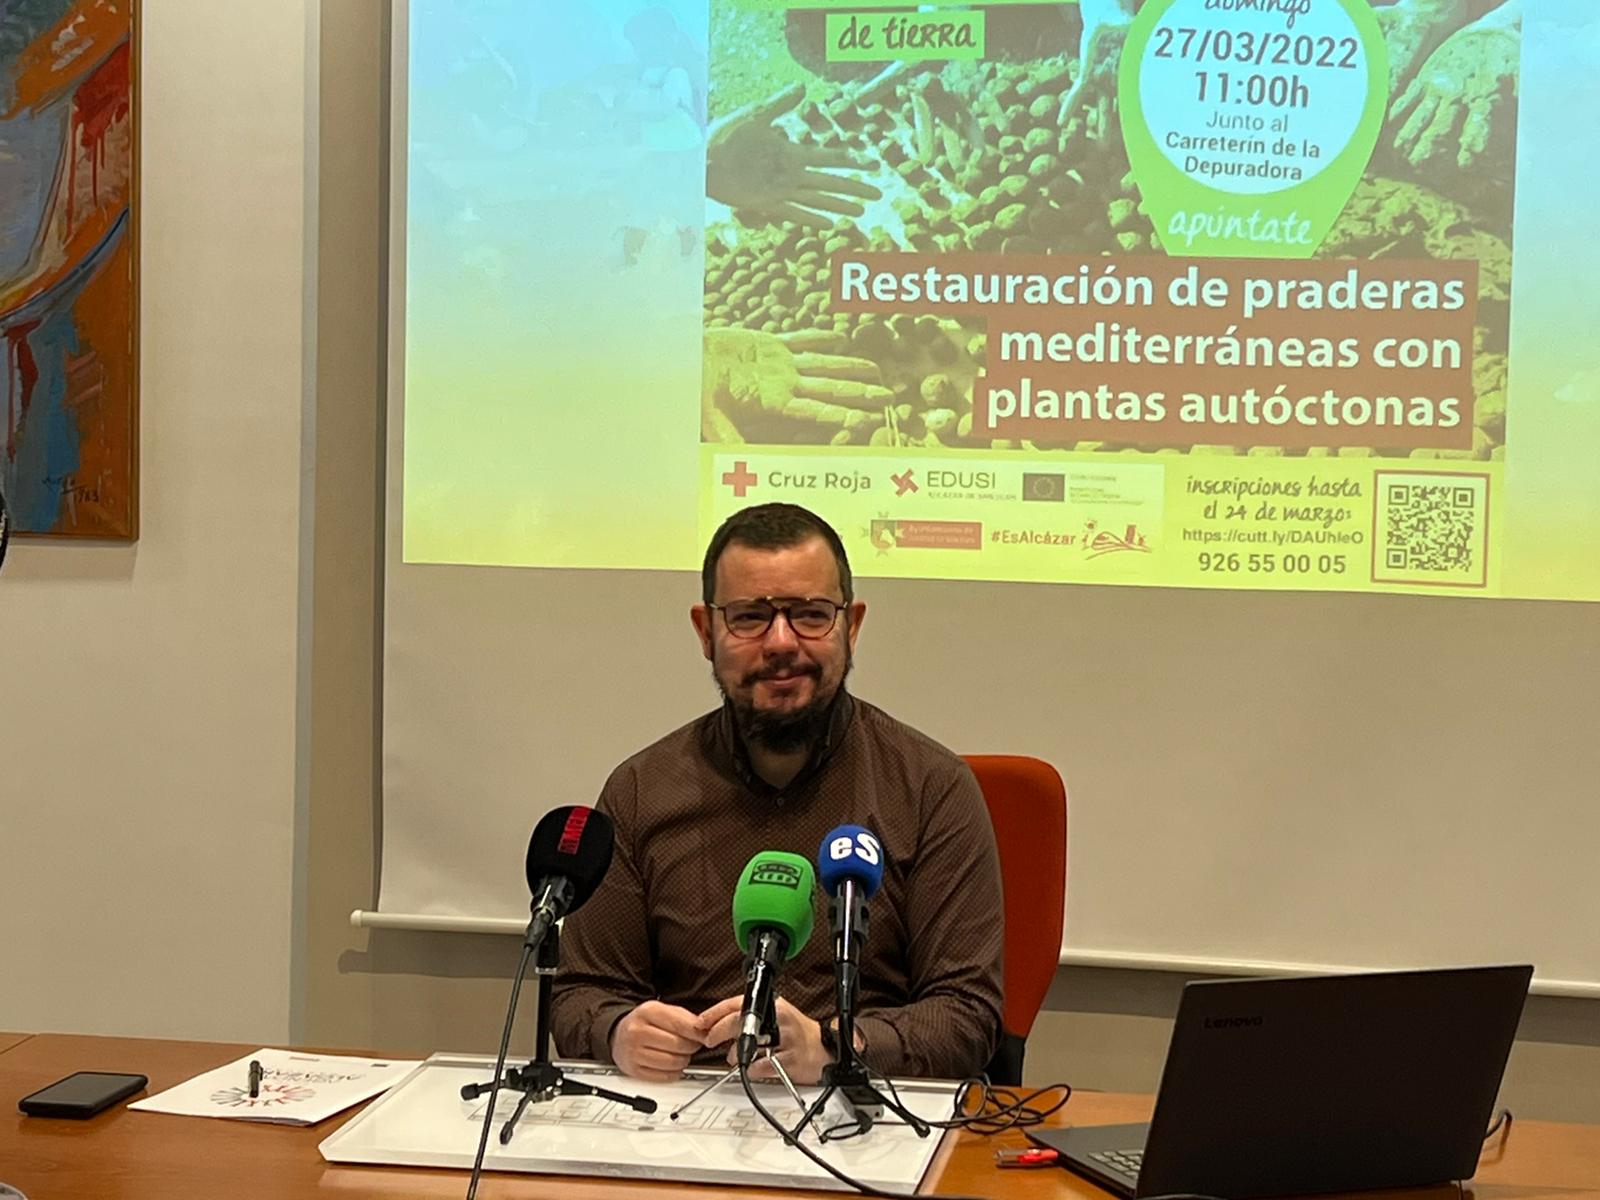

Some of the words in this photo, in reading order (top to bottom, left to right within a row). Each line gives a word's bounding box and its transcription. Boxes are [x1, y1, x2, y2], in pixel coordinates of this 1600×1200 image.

[838, 16, 873, 50] de
[1154, 27, 1359, 69] 27/03/2022
[1195, 71, 1310, 109] 11:00h
[1206, 110, 1265, 132] Junto
[1270, 114, 1289, 133] al
[1165, 131, 1265, 155] Carreterín
[1272, 135, 1295, 157] de
[1302, 138, 1321, 159] la
[1184, 156, 1303, 182] Depuradora
[1168, 205, 1313, 247] apúntate
[841, 262, 1153, 305] Restauración
[1168, 266, 1229, 307] de
[1244, 269, 1465, 318] praderas
[1001, 321, 1360, 368] mediterráneas
[1373, 337, 1461, 369] con
[988, 378, 1166, 428] plantas
[1179, 385, 1460, 427] autóctonas
[768, 471, 817, 489] Cruz
[825, 472, 871, 493] Roja
[927, 470, 996, 489] EDUSI
[1308, 475, 1363, 498] hasta
[1204, 500, 1218, 520] el
[1225, 504, 1247, 521] 24
[1255, 500, 1278, 522] de
[991, 530, 1076, 546] #EsAlcázar
[1199, 552, 1241, 573] 926
[1248, 553, 1275, 573] 55
[1283, 554, 1310, 574] 00
[1318, 555, 1347, 575] 05
[830, 832, 880, 866] eS
